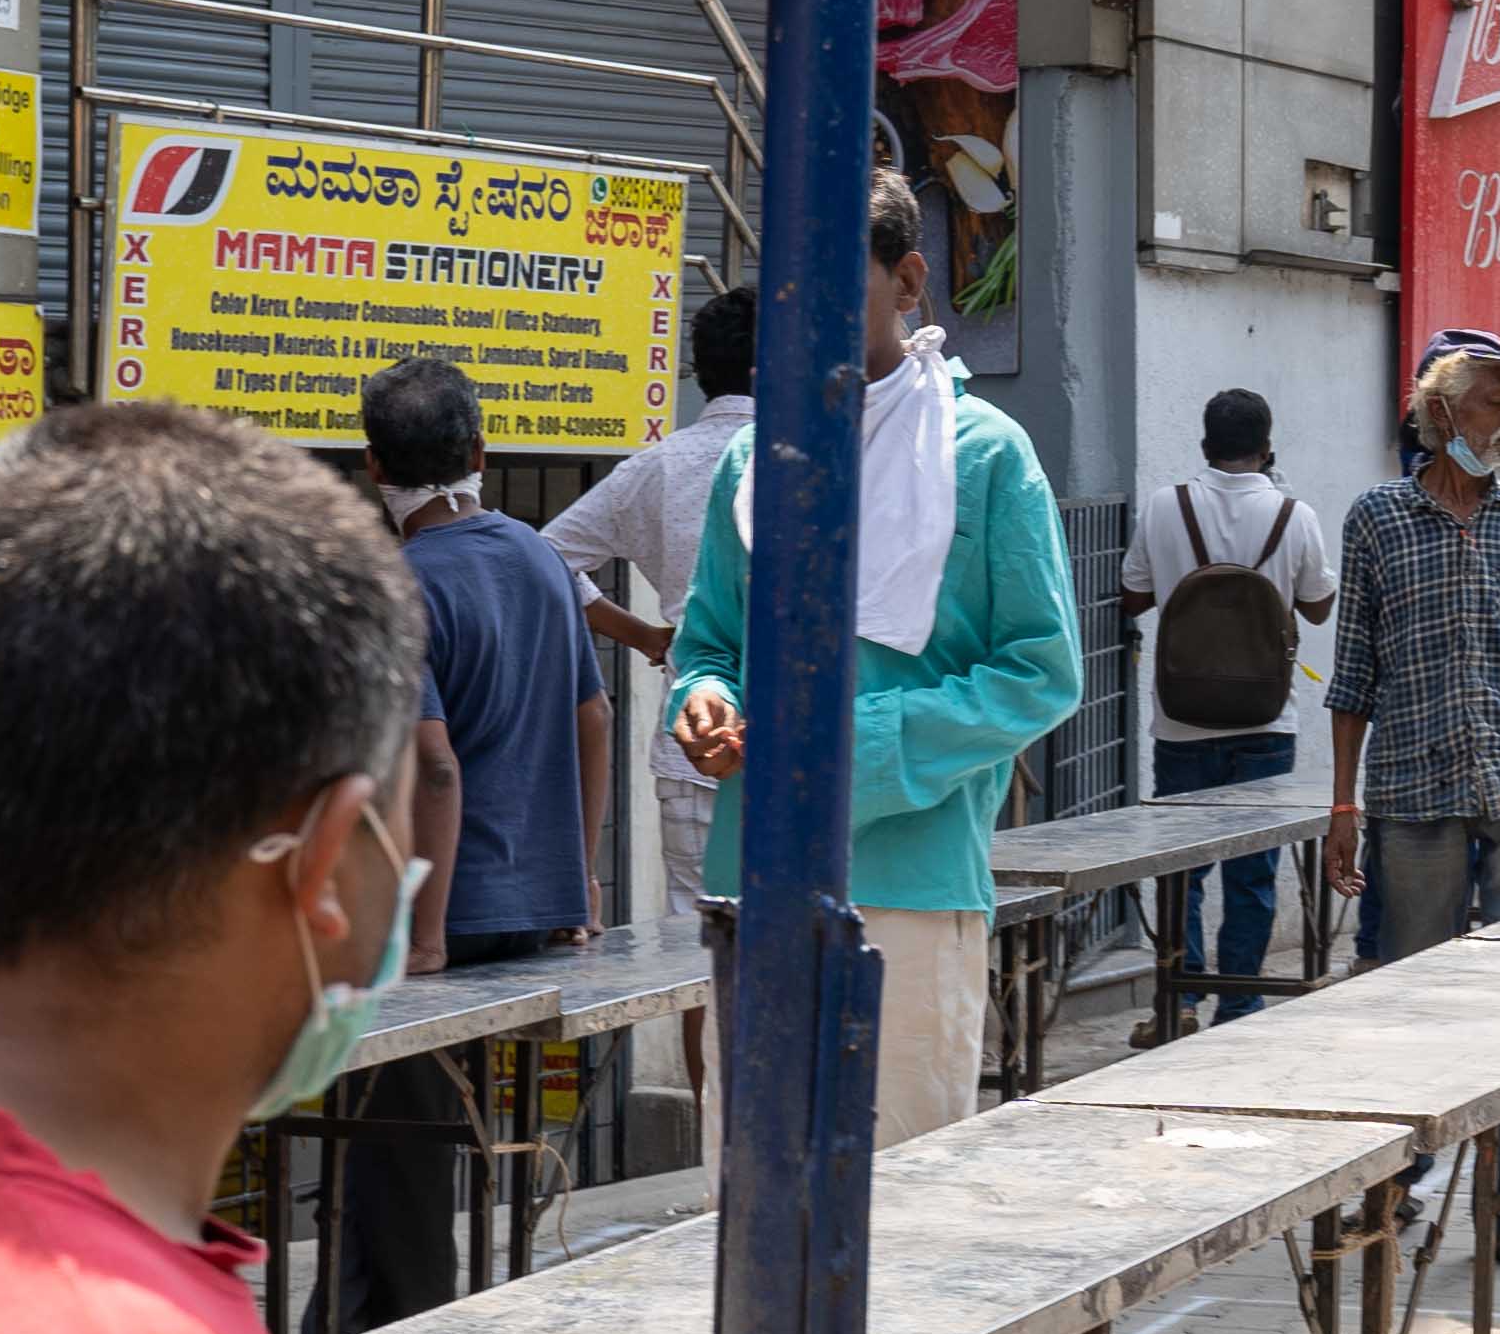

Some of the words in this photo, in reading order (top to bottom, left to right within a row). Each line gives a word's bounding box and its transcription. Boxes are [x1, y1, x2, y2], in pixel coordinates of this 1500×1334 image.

[266, 147, 421, 208] ಮಮತಾ
[434, 160, 572, 237] ಸ್ಟೇಷನರಿ
[216, 228, 376, 278] MAMTA
[386, 243, 603, 294] STATIONERY
[117, 232, 151, 409] XERO
[211, 291, 248, 315] Color
[295, 296, 359, 321] Computer
[453, 306, 493, 328] School
[506, 310, 538, 332] Office
[171, 328, 270, 356] Housekeeping
[366, 338, 379, 358] W
[381, 339, 414, 360] Laser
[549, 347, 583, 370] Spiral
[215, 368, 234, 390] All
[237, 369, 276, 393] Types
[279, 371, 293, 392] of
[295, 372, 357, 397] Cartridge
[524, 381, 557, 402] Smart
